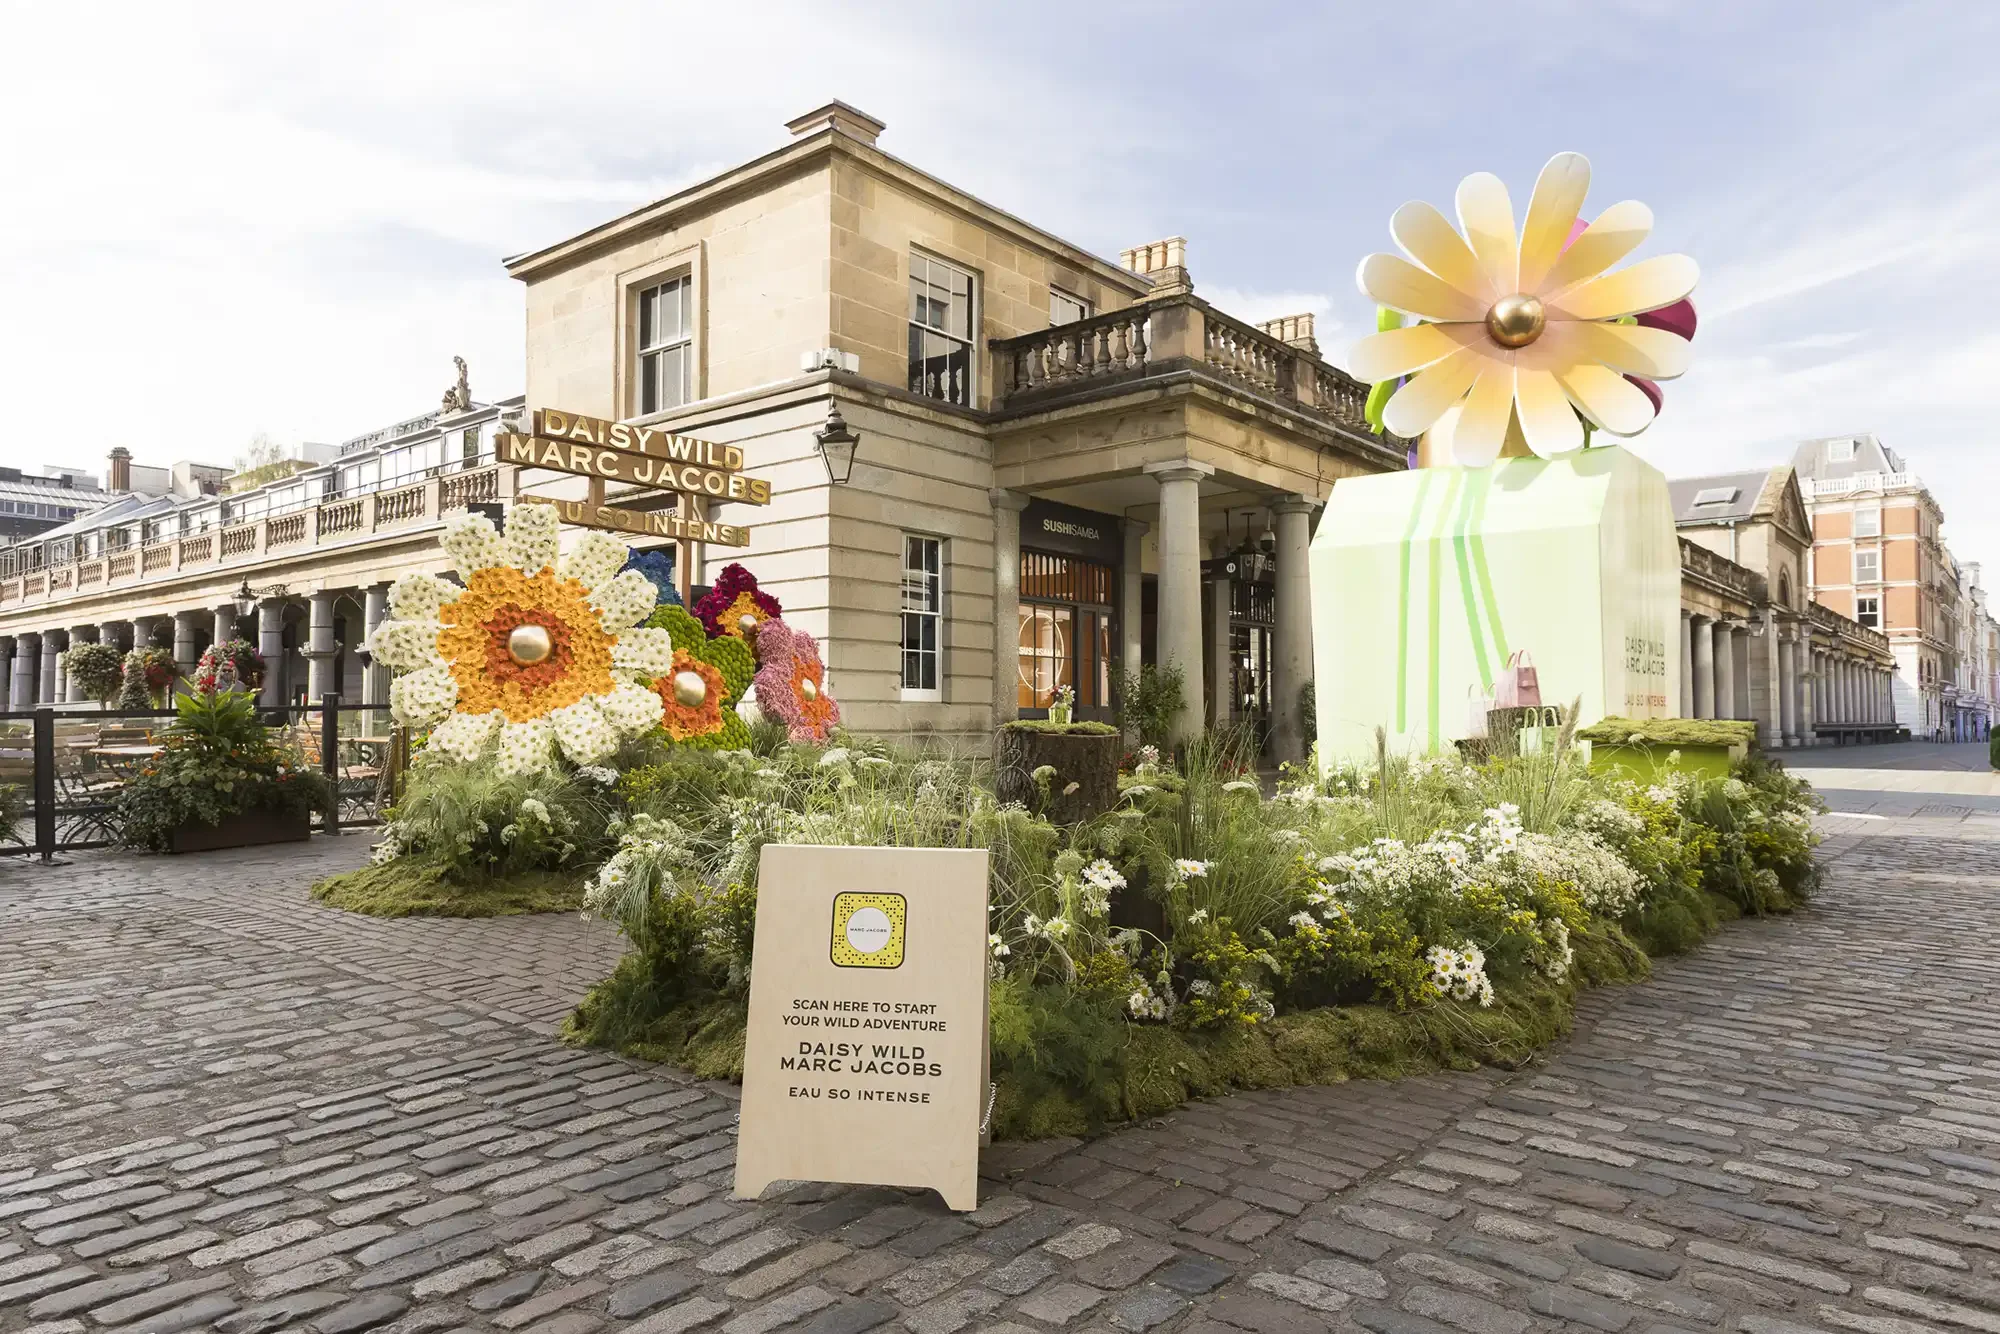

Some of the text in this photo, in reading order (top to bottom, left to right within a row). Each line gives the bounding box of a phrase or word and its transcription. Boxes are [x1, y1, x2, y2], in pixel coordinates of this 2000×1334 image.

[544, 409, 744, 469] DAISY WILD
[509, 434, 770, 502] MARC JACOBS
[595, 506, 632, 528] SO
[1043, 519, 1099, 540] SUSHISAMBA
[793, 999, 937, 1015] SCAN HERE TO START
[782, 1015, 947, 1032] YOUR WILD ADVENTURE
[799, 1041, 925, 1060] DAISY WILD
[780, 1057, 942, 1076] MARC JACOBS
[789, 1086, 930, 1104] EAU SO INTENSE
